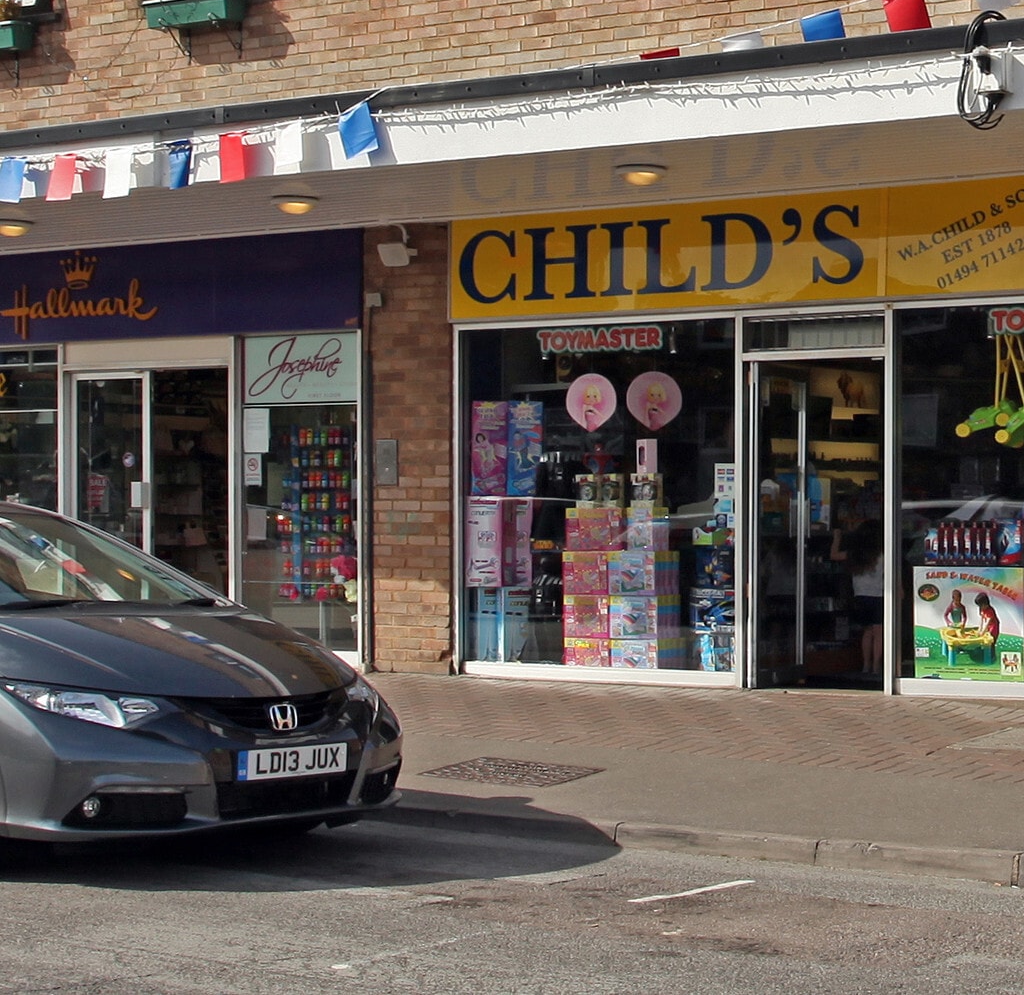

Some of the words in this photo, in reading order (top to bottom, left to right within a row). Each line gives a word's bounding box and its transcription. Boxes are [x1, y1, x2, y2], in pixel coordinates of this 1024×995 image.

[458, 204, 865, 304] CHILD'S
[896, 210, 986, 262] W.A.CHILD
[990, 203, 1003, 217] &
[941, 238, 974, 264] EST
[977, 221, 1012, 246] 1878
[936, 260, 980, 289] 01494
[0, 278, 159, 340] Hallmark
[538, 326, 662, 352] TOYMASTER
[248, 336, 343, 400] Josephine
[926, 571, 948, 580] SAND
[960, 572, 992, 588] WATER
[991, 581, 1018, 601] TABLE
[255, 750, 300, 775] LD13
[305, 746, 340, 770] JUX
